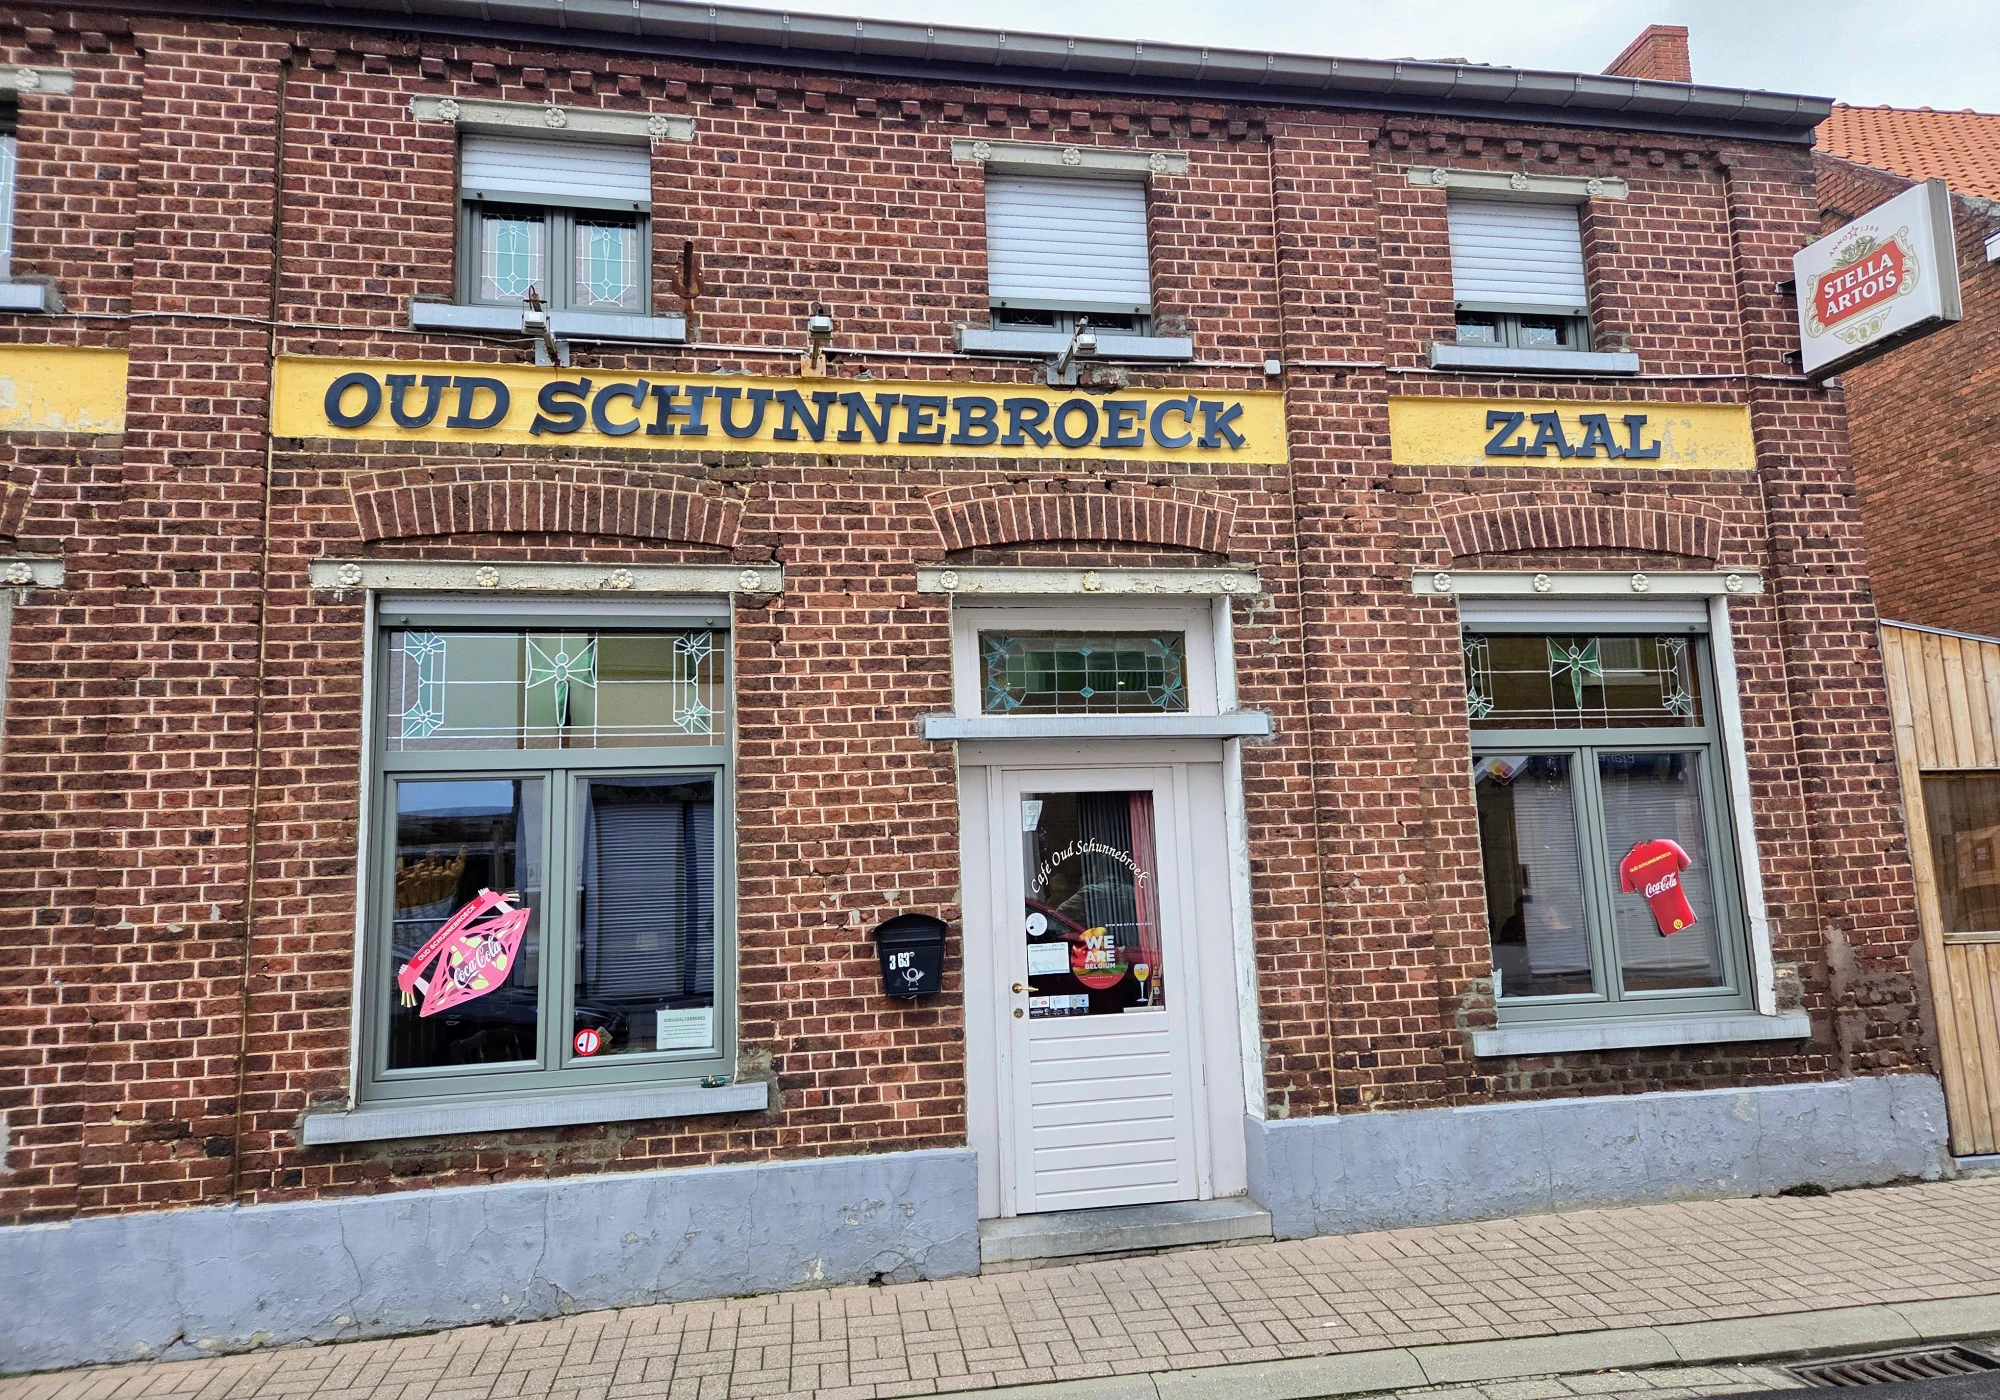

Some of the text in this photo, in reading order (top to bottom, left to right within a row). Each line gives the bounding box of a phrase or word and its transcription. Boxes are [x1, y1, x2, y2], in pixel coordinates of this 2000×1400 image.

[1829, 234, 1848, 257] ANNO
[1824, 253, 1895, 299] STELLA
[1825, 270, 1898, 318] ARTOIS
[323, 371, 1247, 451] OUD SCHUNNEBROECK
[1484, 410, 1662, 459] ZAAL
[1031, 837, 1150, 894] Café Oud Schunnebroek
[417, 904, 477, 962] OUD SCHUNNEBROECK
[1084, 935, 1115, 950] WE
[1085, 950, 1116, 963] ARE
[1085, 962, 1116, 970] BELGIUM
